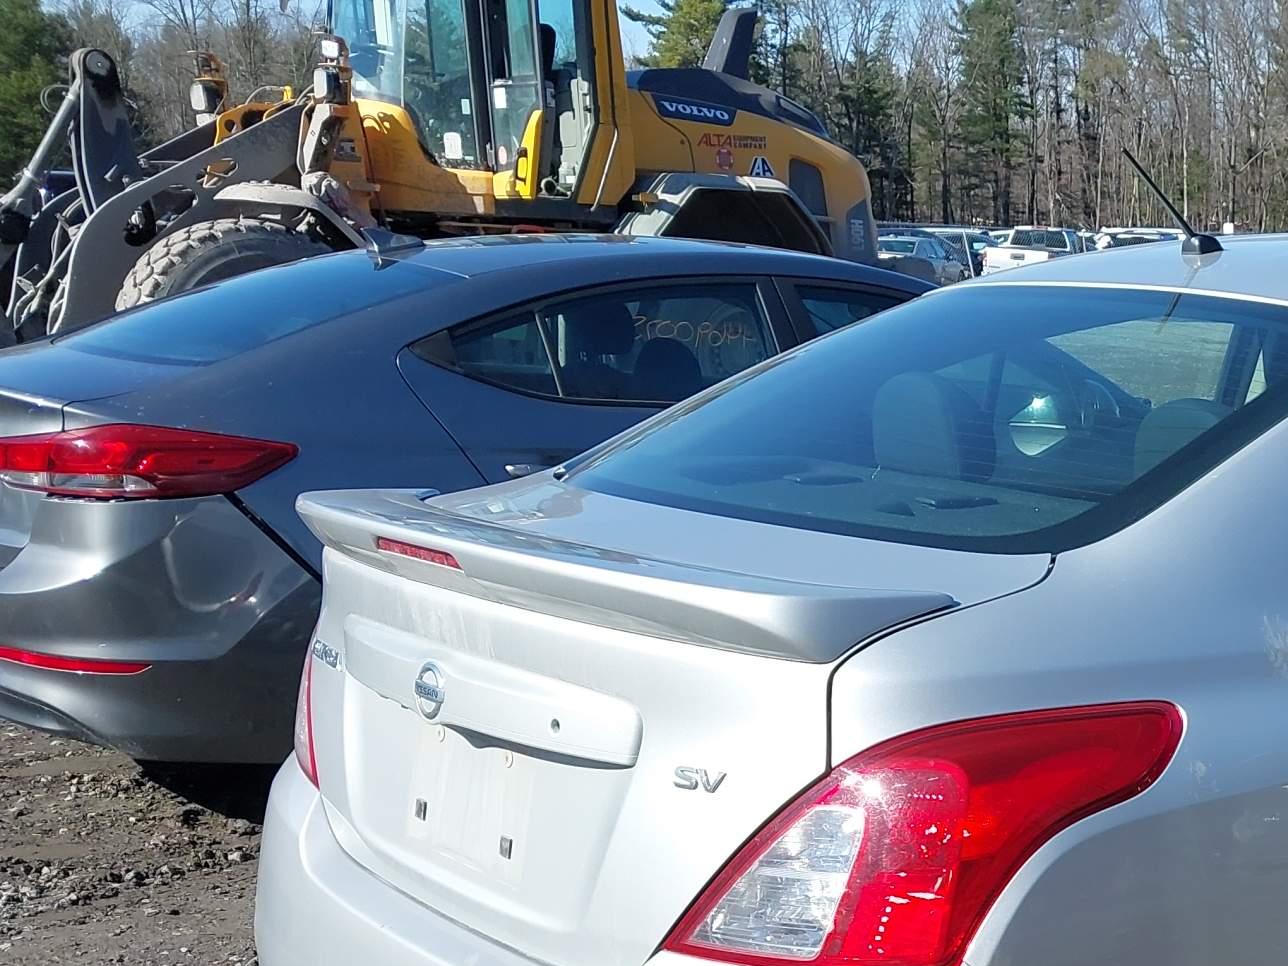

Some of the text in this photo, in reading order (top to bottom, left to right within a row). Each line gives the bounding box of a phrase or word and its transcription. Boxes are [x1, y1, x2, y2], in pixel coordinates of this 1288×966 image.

[660, 101, 729, 120] VOLVO
[697, 133, 733, 148] ALTA
[673, 766, 727, 793] SV
